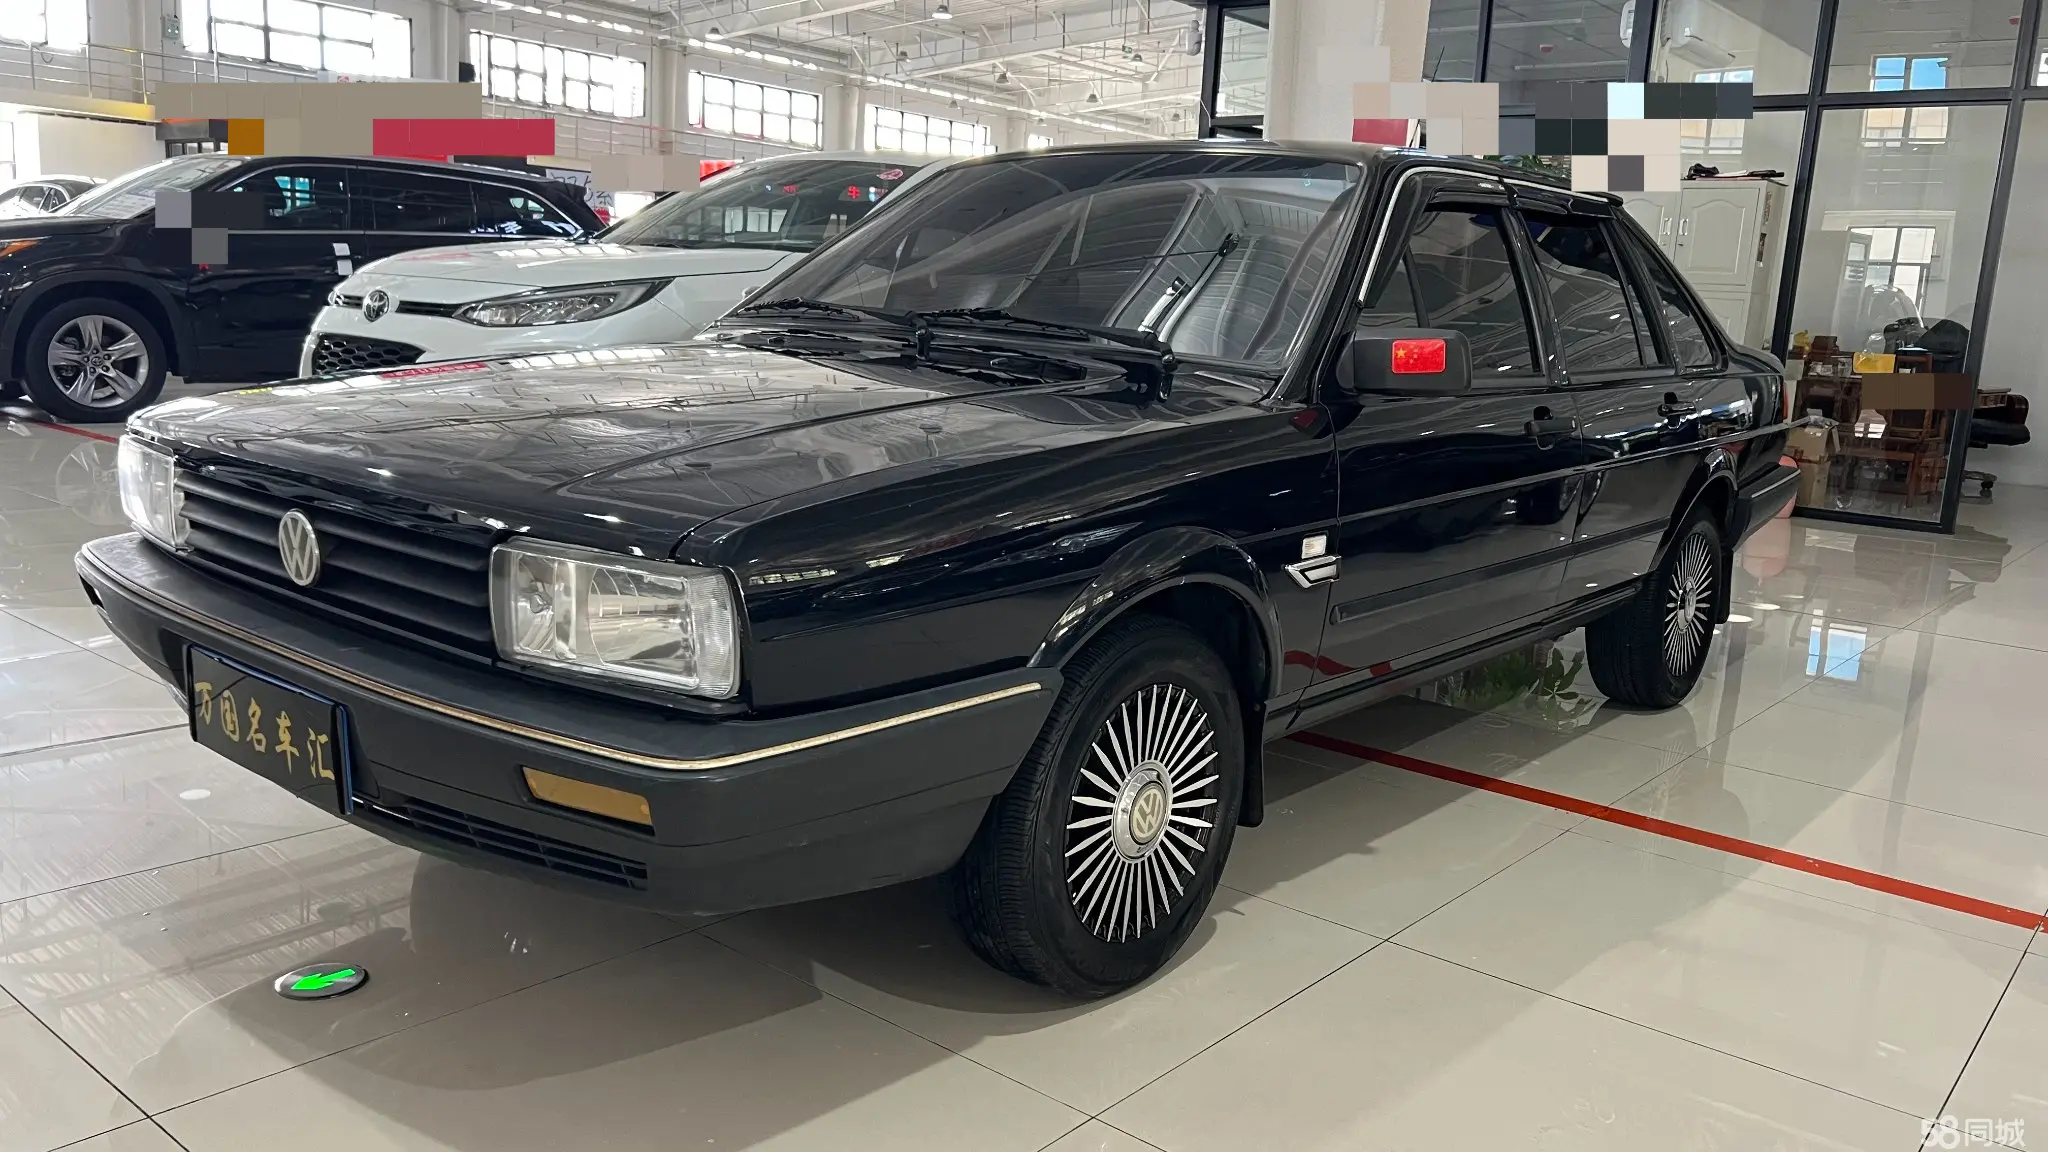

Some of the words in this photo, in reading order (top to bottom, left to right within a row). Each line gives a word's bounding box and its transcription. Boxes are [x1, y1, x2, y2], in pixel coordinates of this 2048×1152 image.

[194, 681, 335, 781] 万国名车汇
